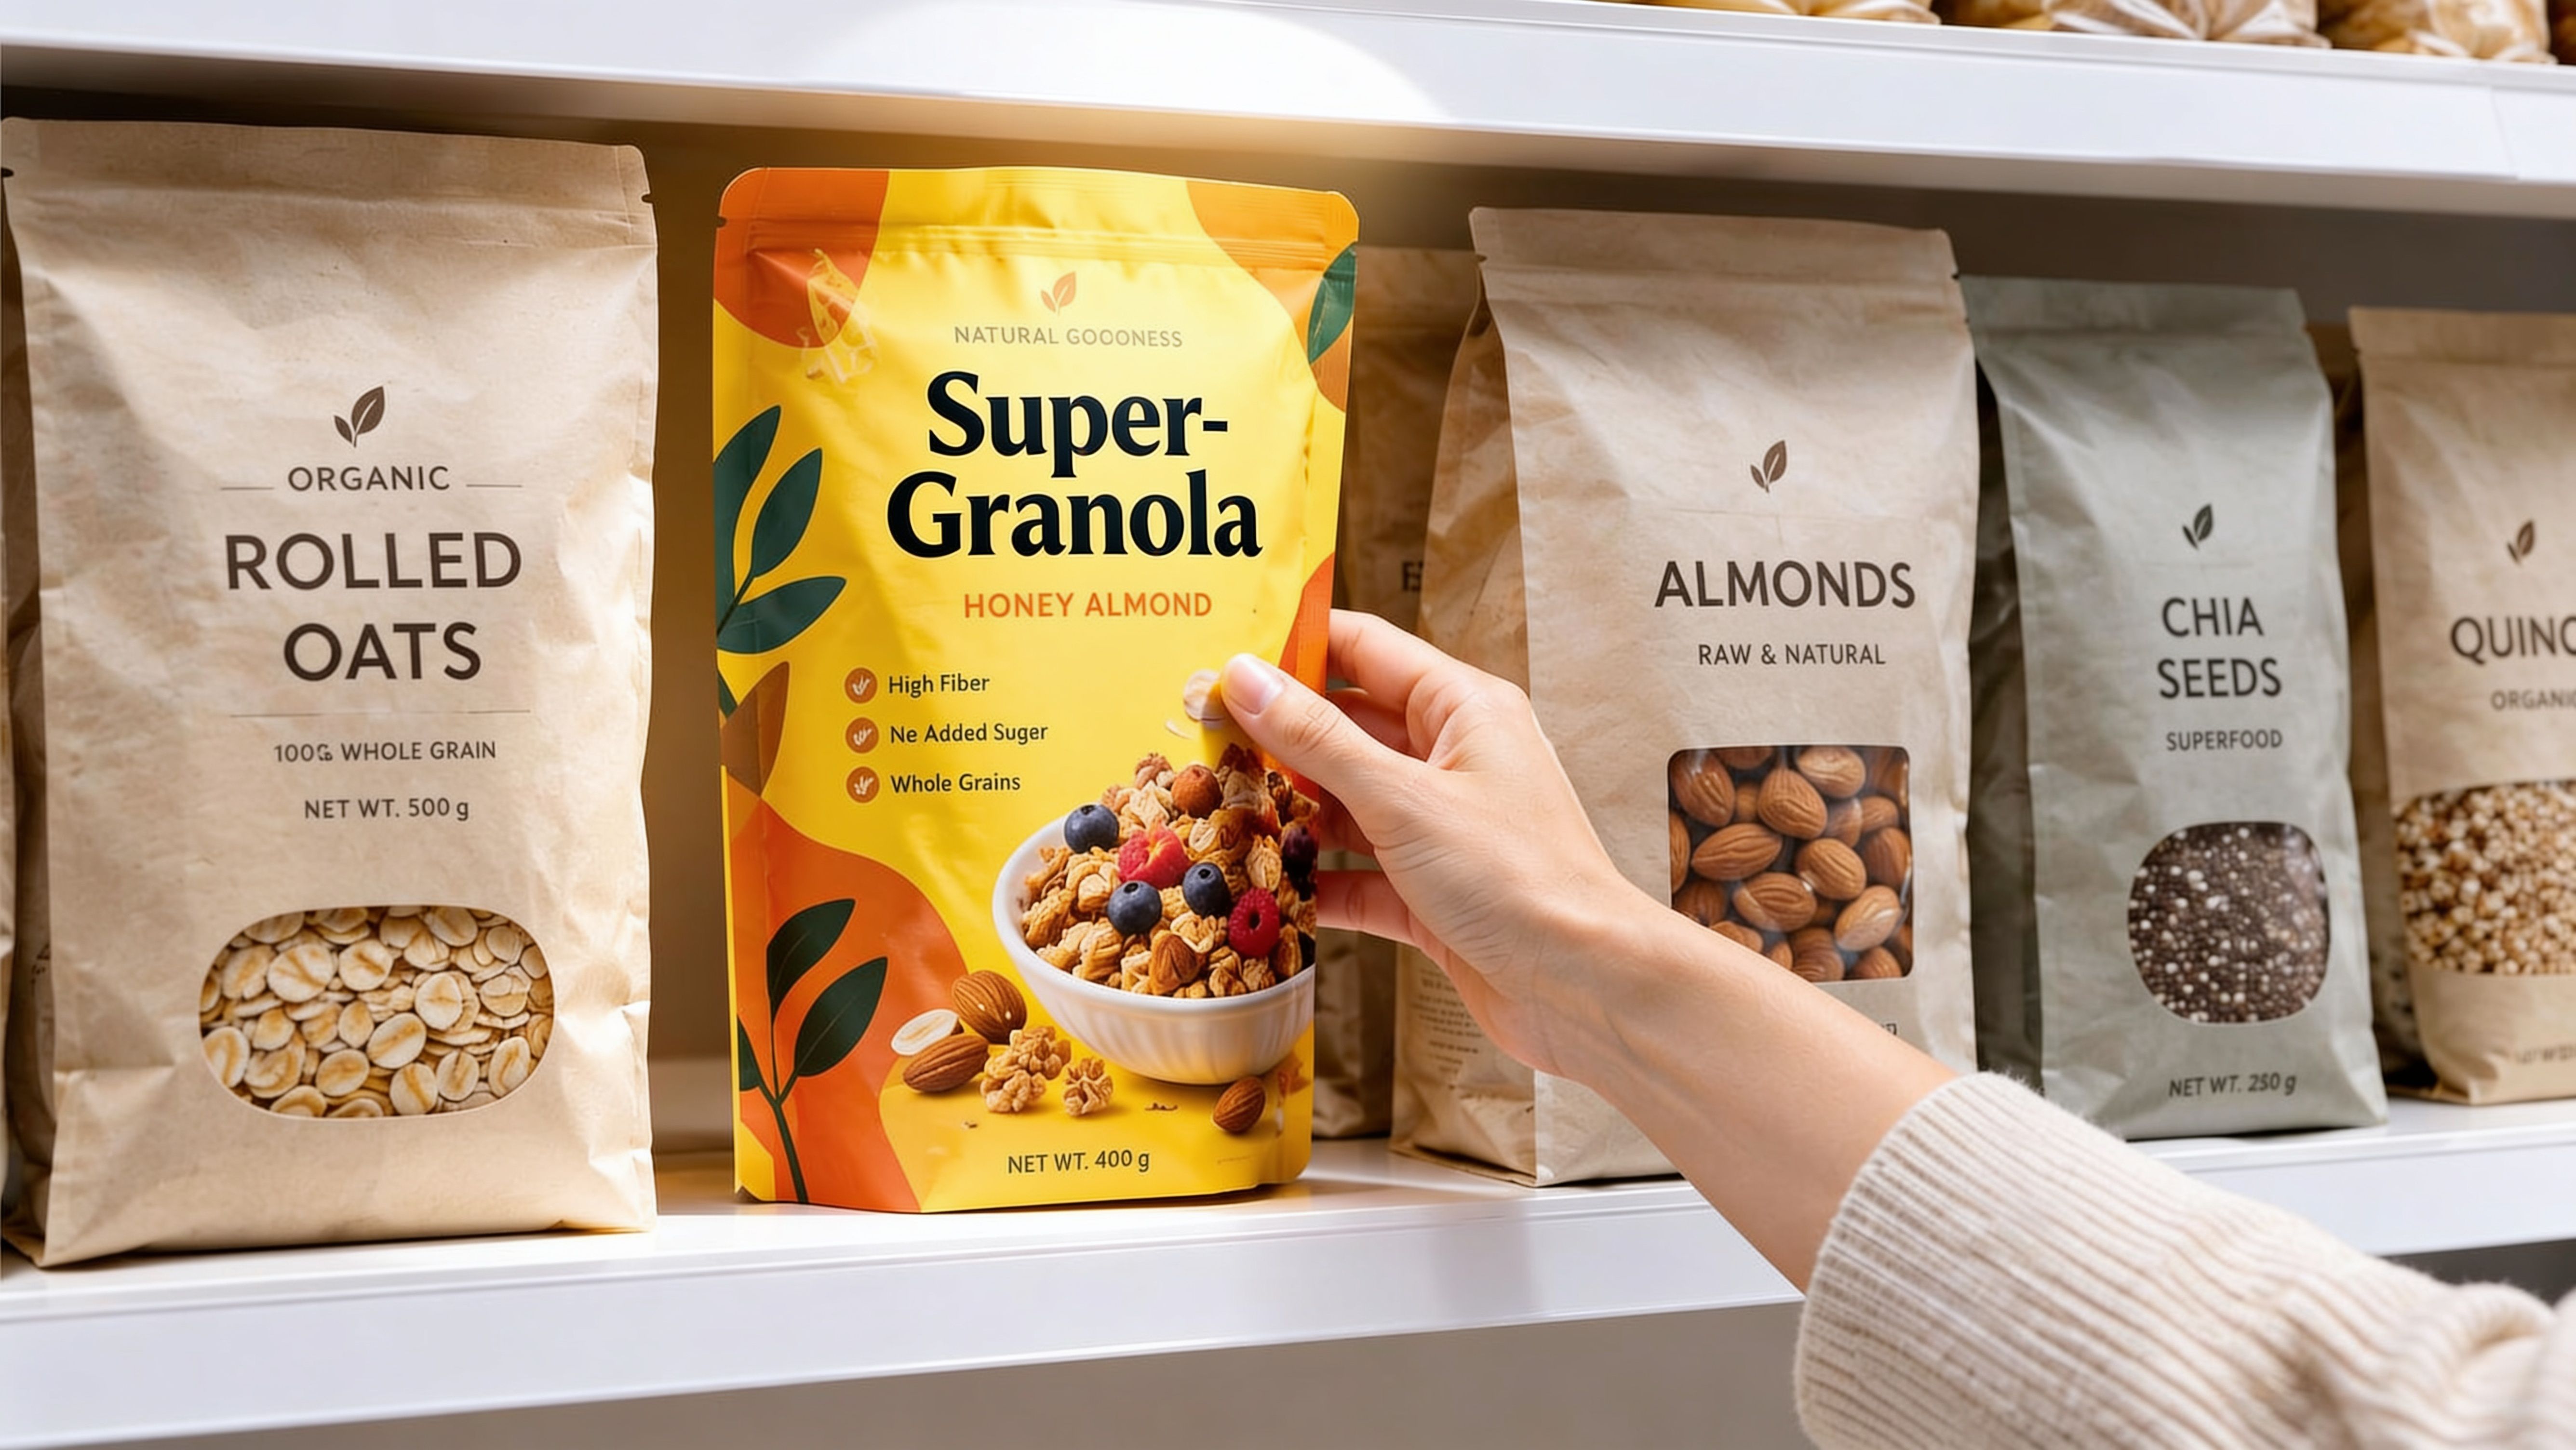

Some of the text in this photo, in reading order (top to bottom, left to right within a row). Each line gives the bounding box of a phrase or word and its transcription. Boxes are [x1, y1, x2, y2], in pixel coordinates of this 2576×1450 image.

[954, 326, 1059, 344] NATURAL
[926, 371, 1228, 478] Super-
[288, 466, 449, 491] ORGANIC
[887, 470, 1263, 558] Granola
[226, 532, 521, 591] ROLLED
[1654, 561, 1915, 608] ALMONDS
[965, 592, 1211, 618] HONEY ALMOND
[2162, 597, 2264, 638] CHIA
[283, 622, 481, 682] OATS
[1699, 644, 1886, 665] RAW & NATURAL
[889, 673, 990, 698] High Fiber
[2157, 658, 2281, 699] SEEDS
[924, 723, 987, 742] Added
[2166, 729, 2282, 752] SUPERFOOD
[341, 742, 422, 761] WHOLE
[430, 741, 496, 760] GRAIN
[890, 773, 1020, 793] Whole Grains
[305, 798, 469, 821] NET WT. 500 g
[2169, 1072, 2296, 1097] NET WT. 250 g
[1008, 1150, 1150, 1173] NET WT. 400 g
